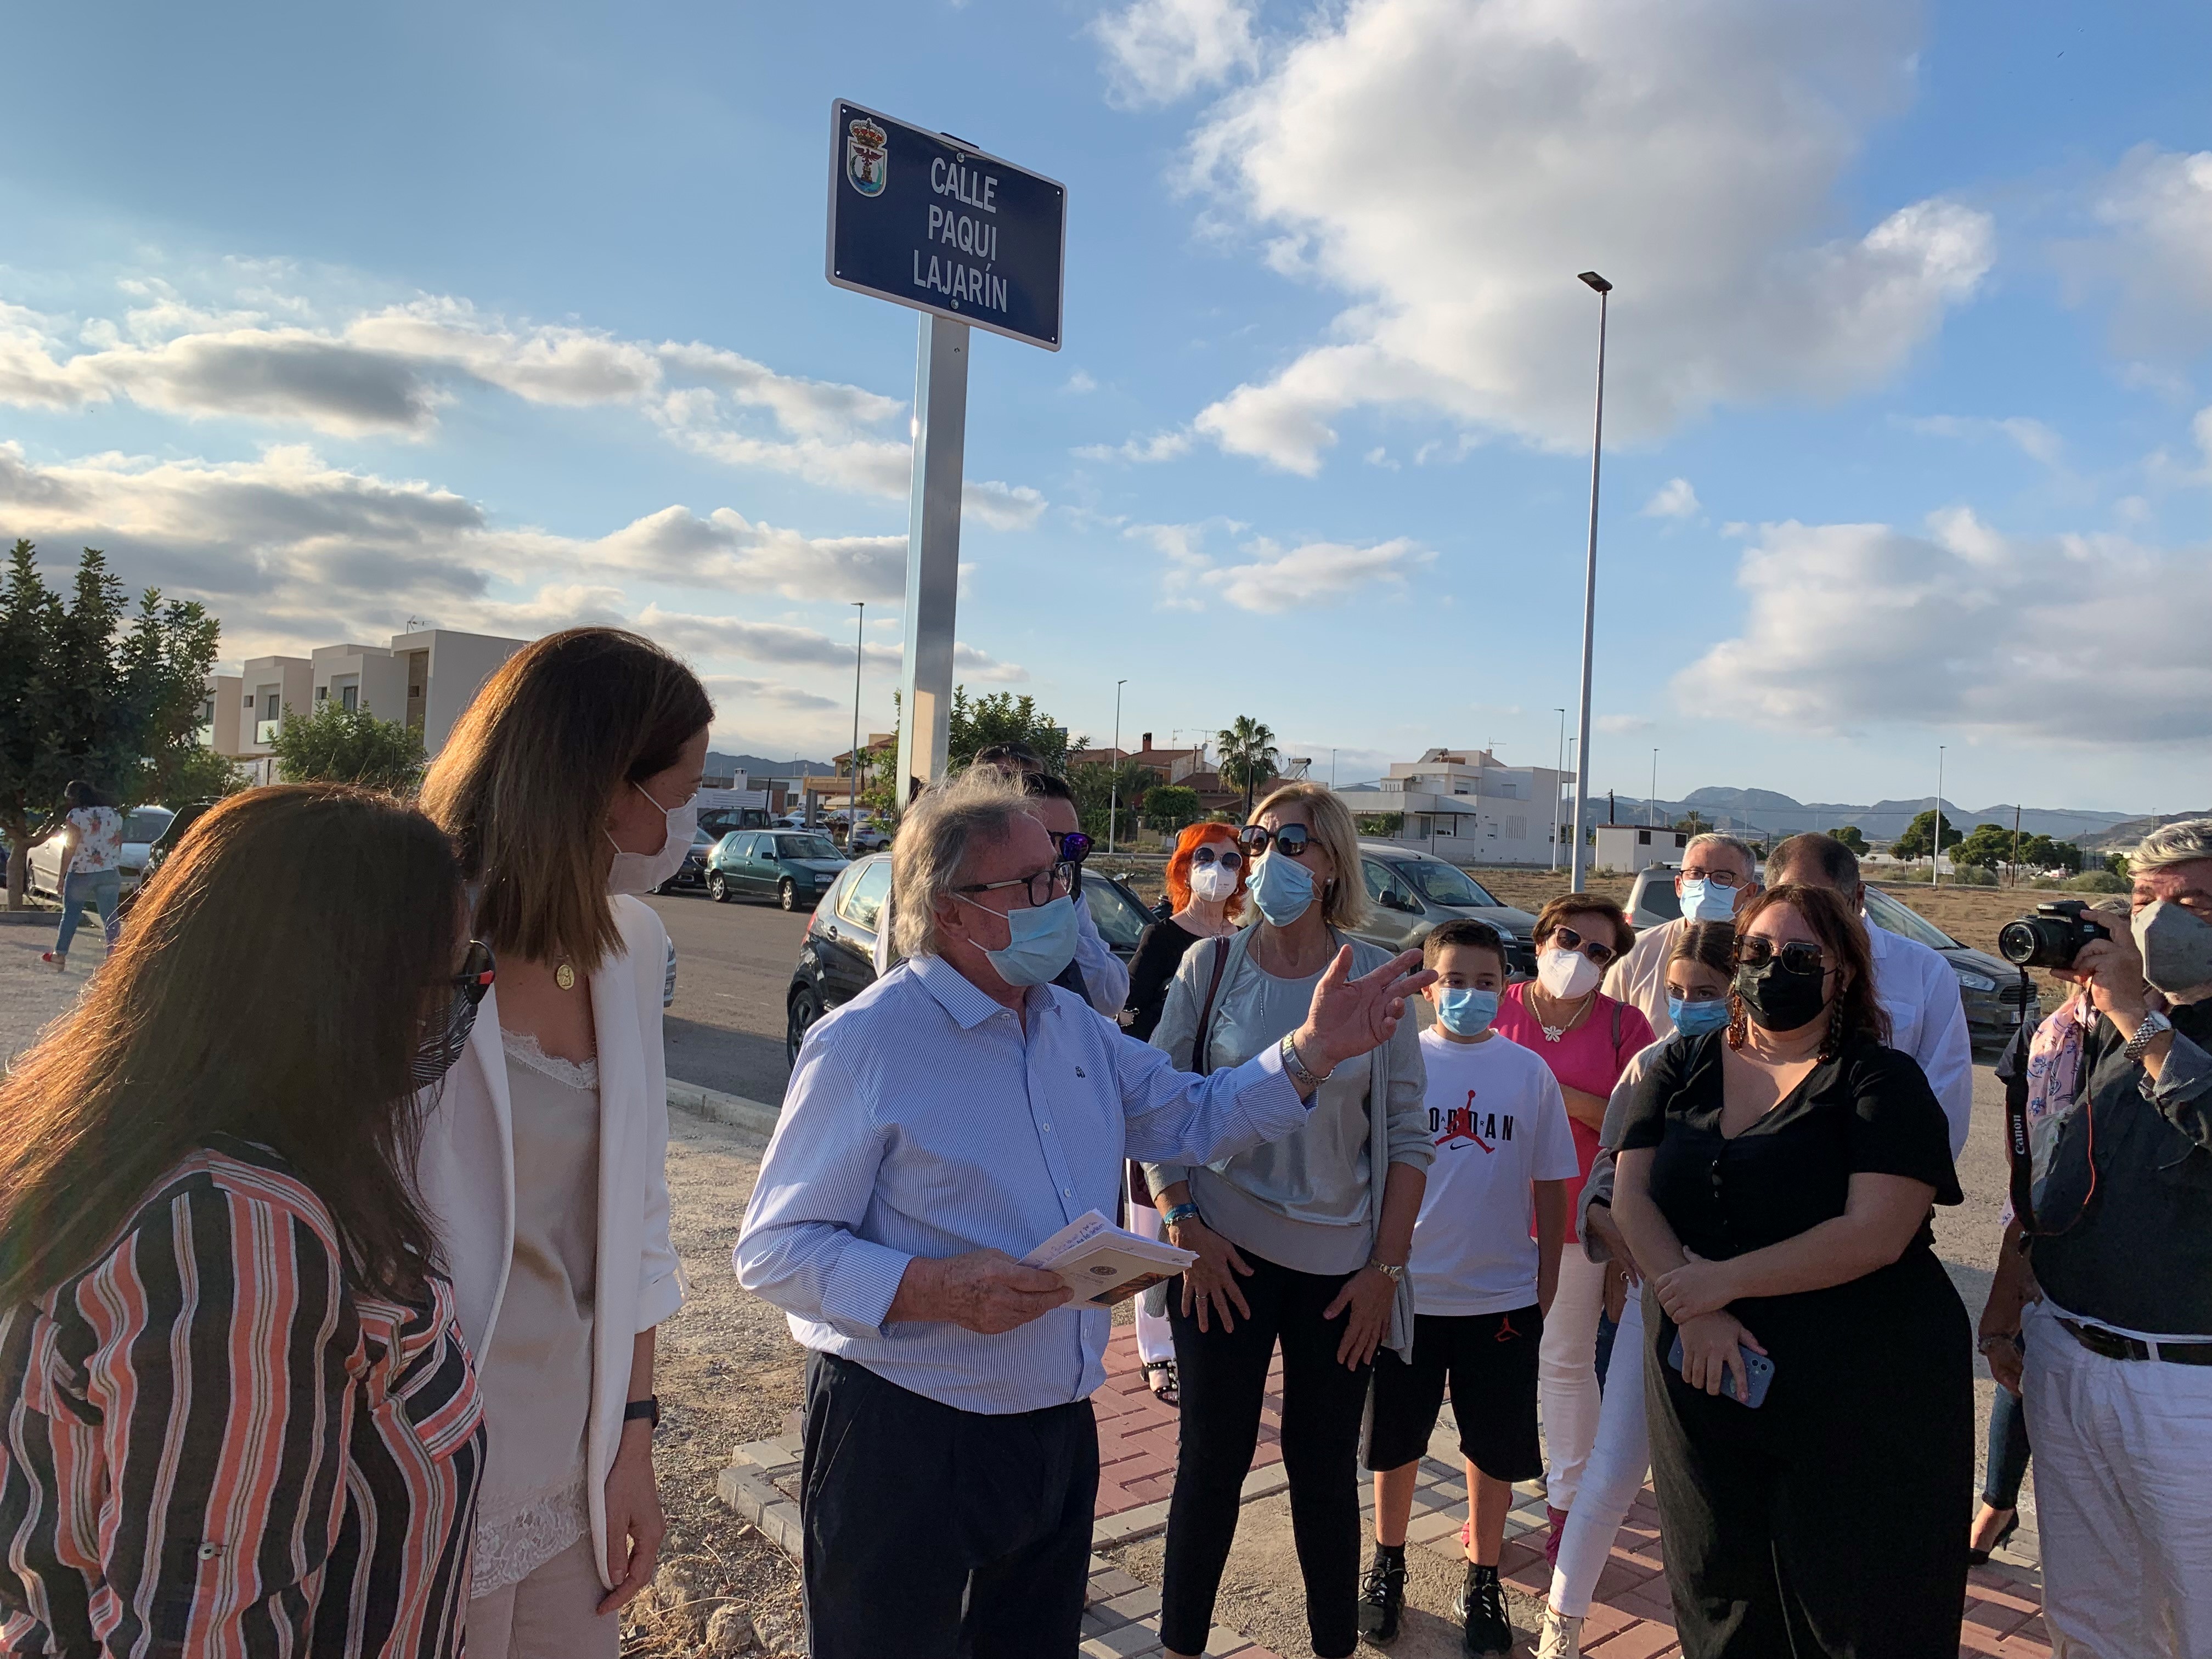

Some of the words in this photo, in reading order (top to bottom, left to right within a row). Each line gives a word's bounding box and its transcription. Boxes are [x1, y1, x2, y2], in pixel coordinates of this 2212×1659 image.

[931, 157, 997, 213] CALLE
[928, 204, 997, 261] PAQUI
[913, 250, 1007, 313] LAJARÍN
[1429, 1107, 1514, 1141] ORDAN
[2013, 1115, 2025, 1155] Canon
